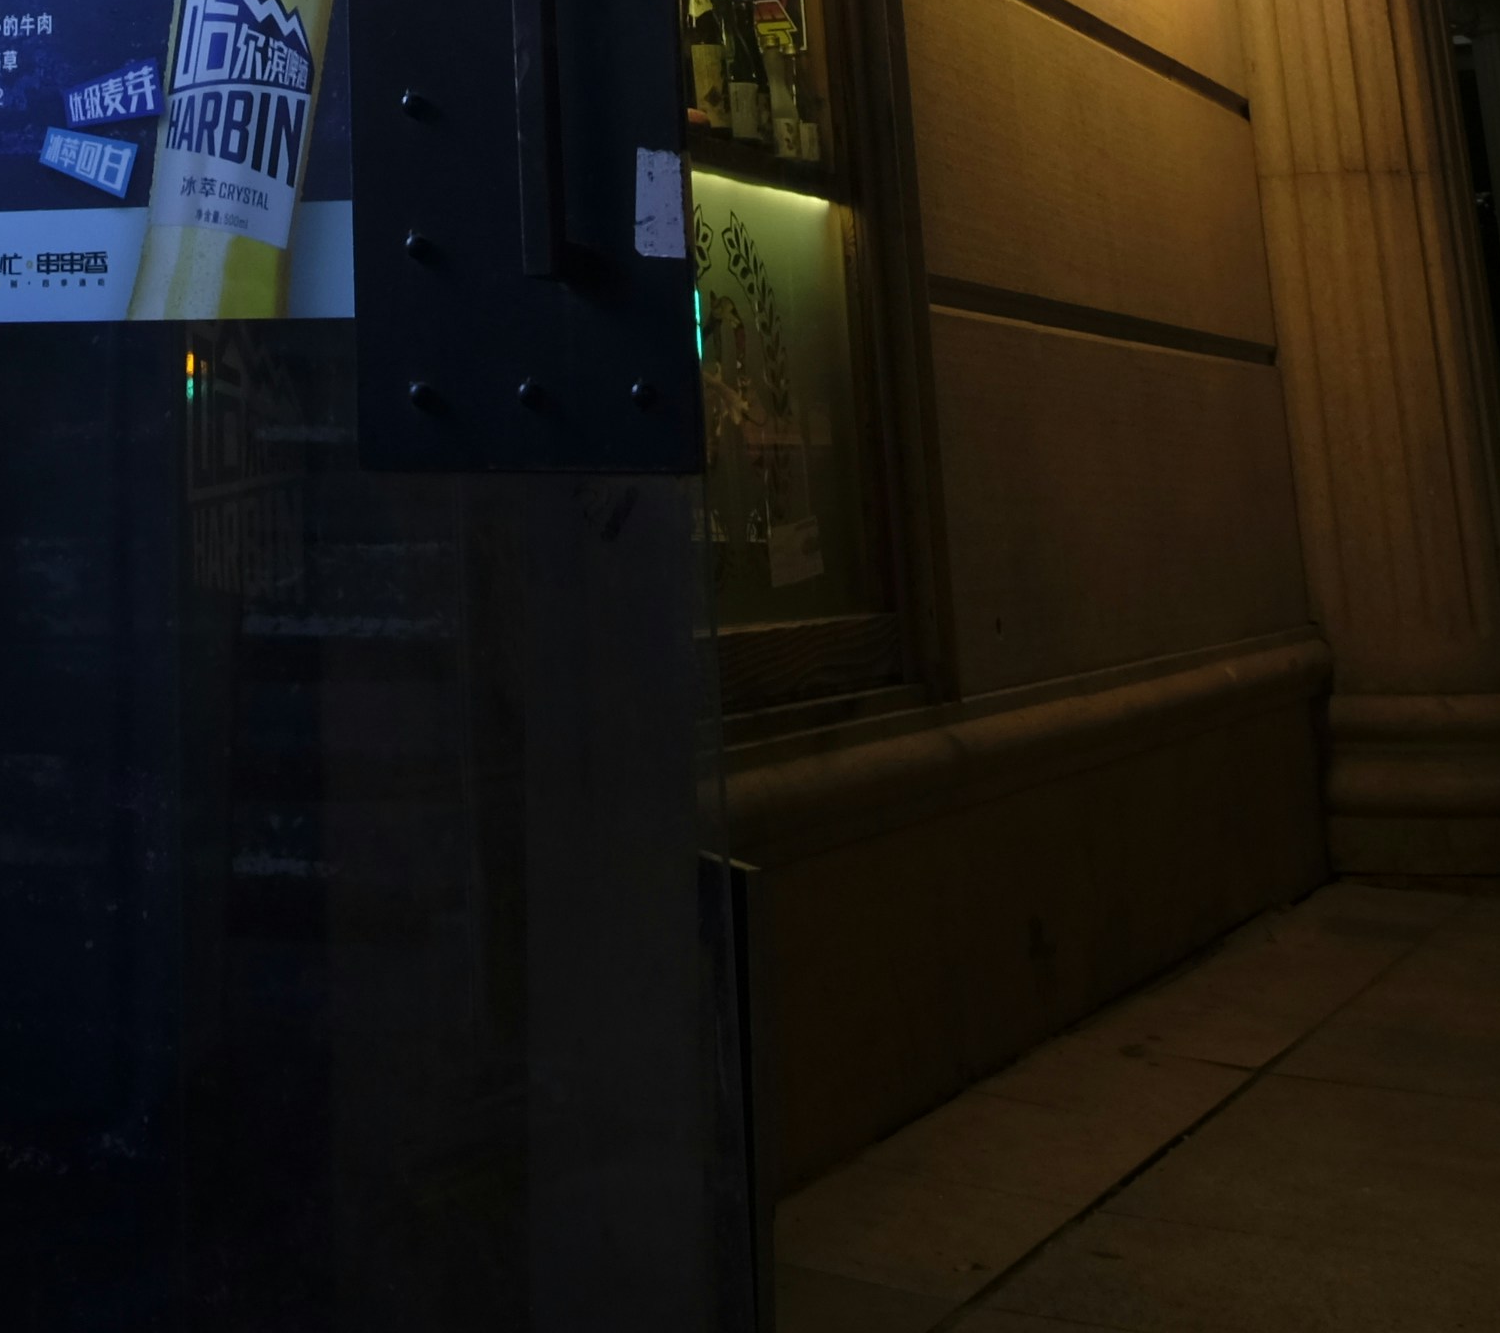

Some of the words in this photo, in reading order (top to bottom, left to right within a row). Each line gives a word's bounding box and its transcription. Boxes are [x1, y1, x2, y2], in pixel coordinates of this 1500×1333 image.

[68, 65, 157, 122] 优级麦芽
[166, 90, 306, 188] HARBIN
[180, 176, 217, 198] 冰萃
[218, 181, 269, 211] CRYSTAL
